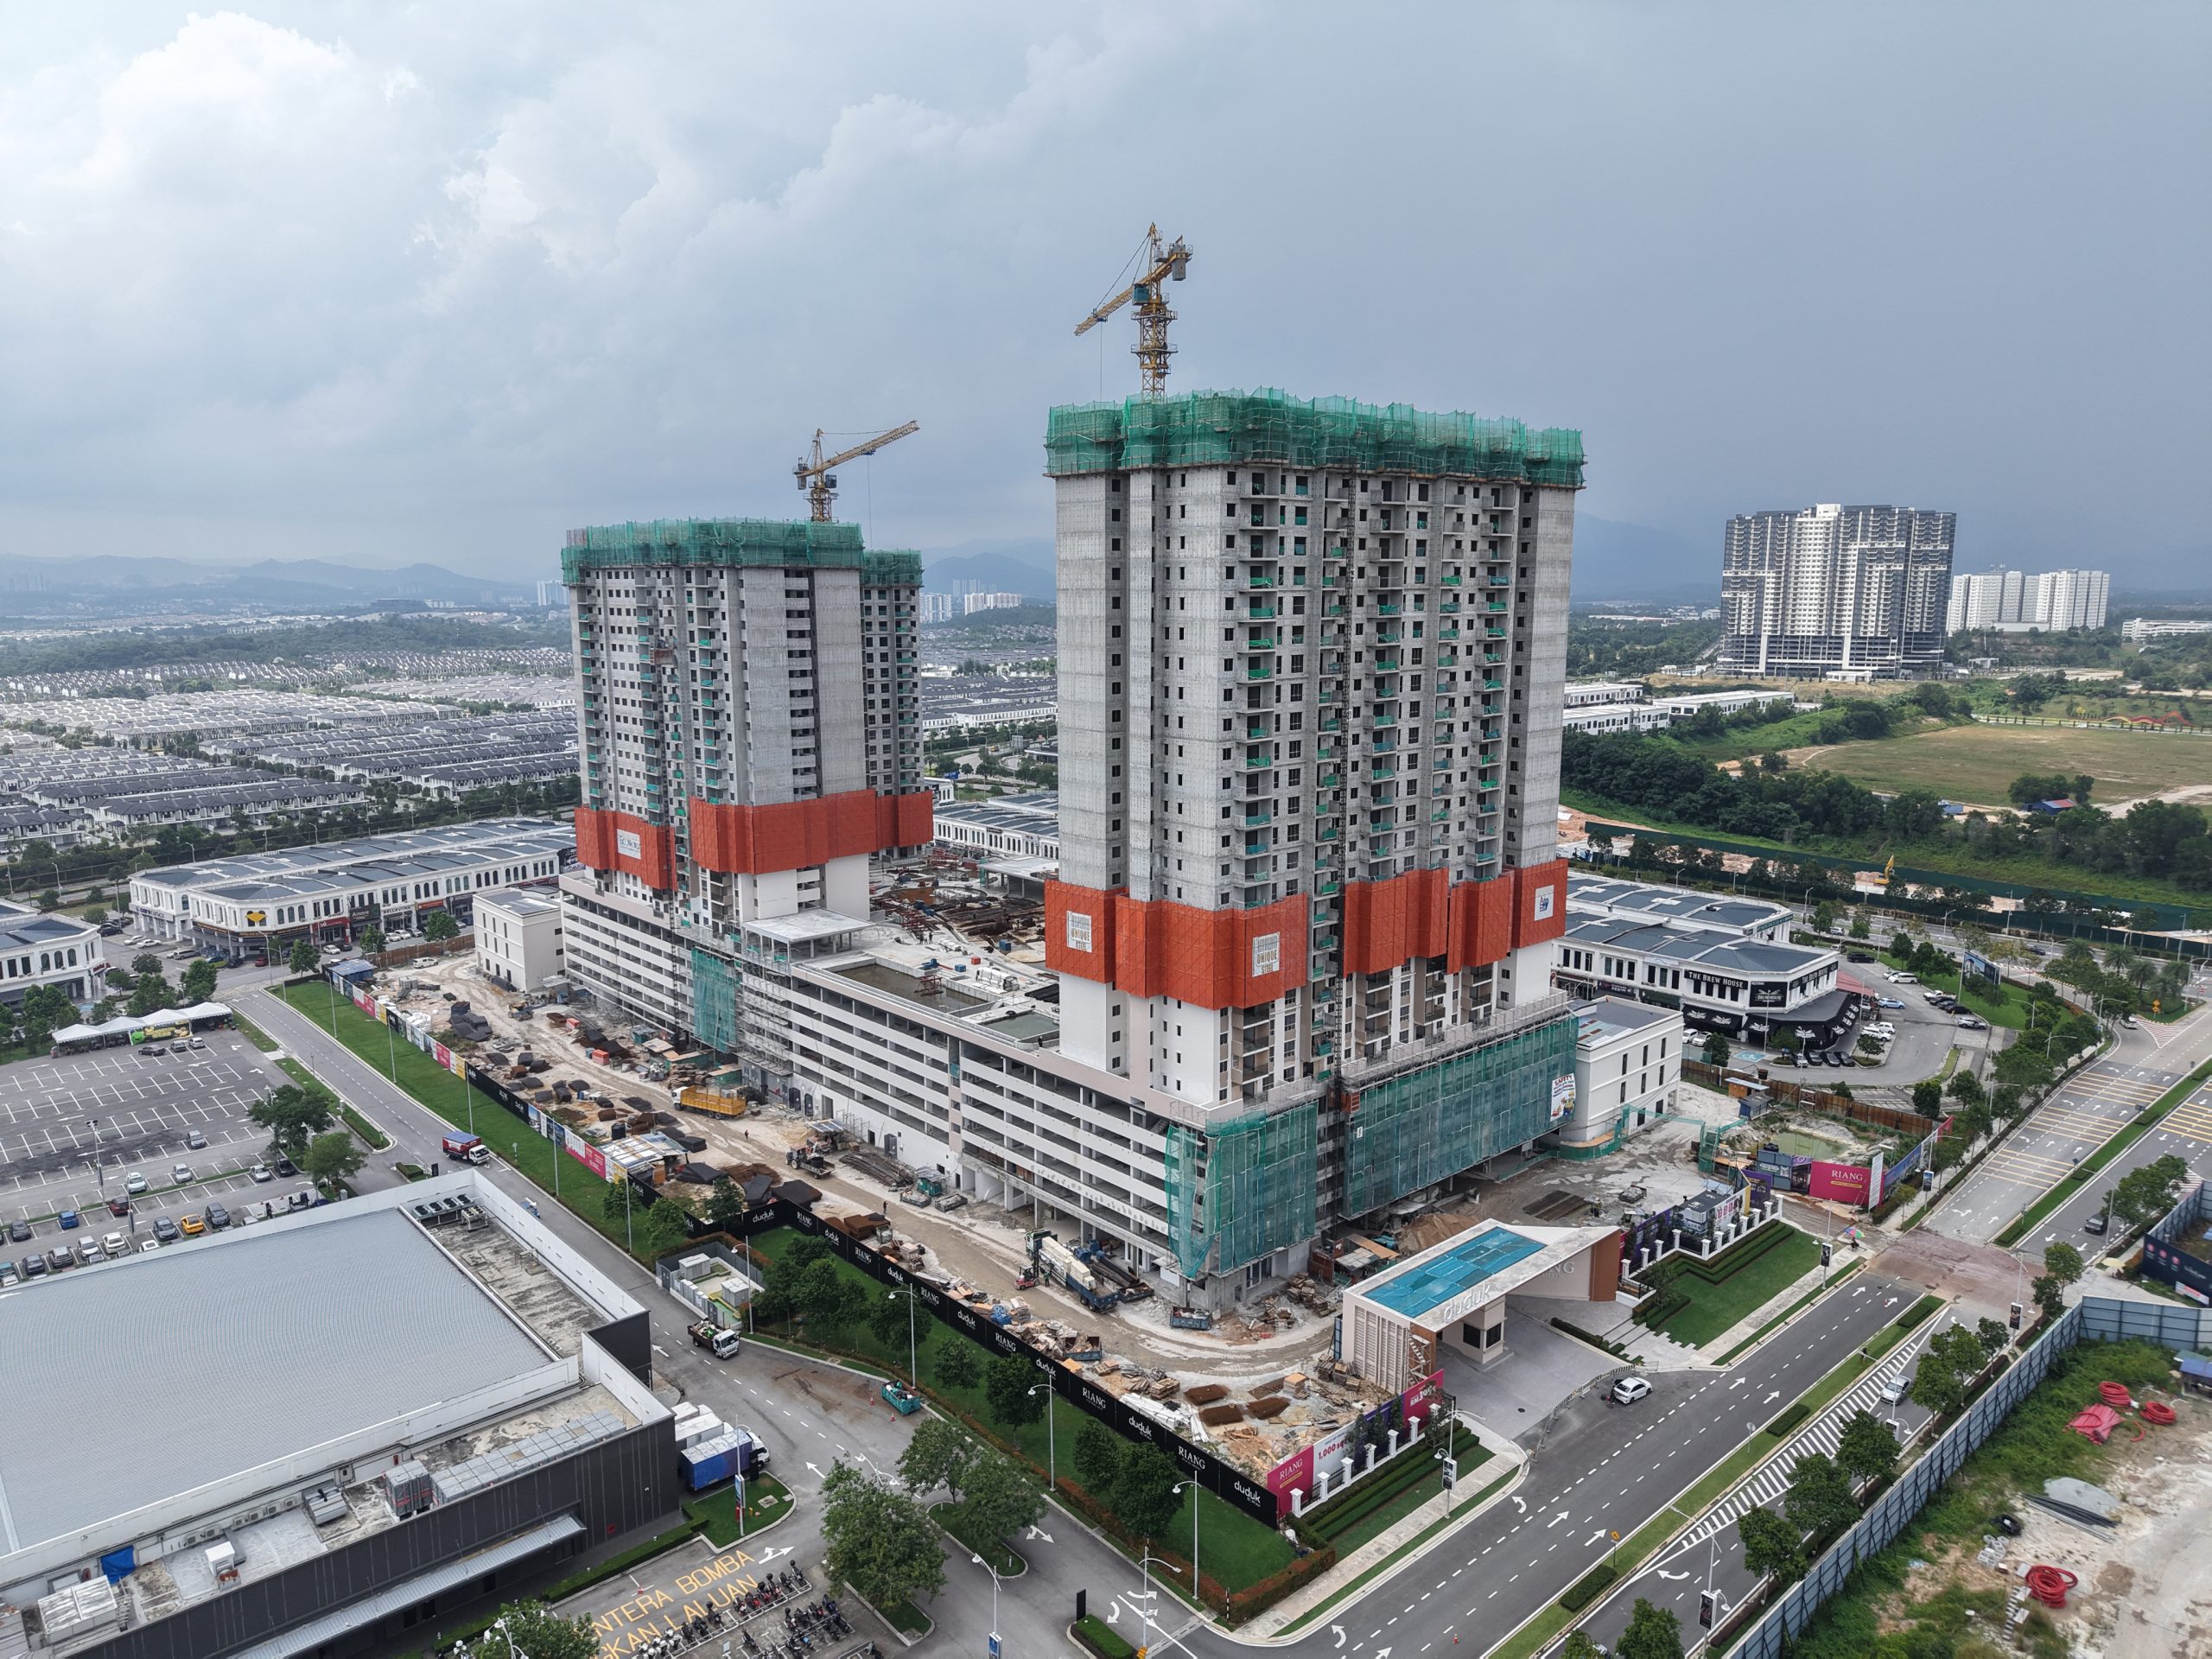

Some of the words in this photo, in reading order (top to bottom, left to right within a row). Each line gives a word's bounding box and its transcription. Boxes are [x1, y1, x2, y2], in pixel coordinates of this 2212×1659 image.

[1257, 950, 1277, 964] UNIQUE
[1688, 971, 1701, 980] THE
[1702, 974, 1721, 984] BREW
[1723, 977, 1744, 988] HOUSE
[1831, 1170, 1863, 1180] RIANG
[752, 1210, 775, 1223] duduk
[797, 1211, 812, 1225] RIANG
[824, 1229, 840, 1243] duduk
[855, 1246, 872, 1263] RIANG
[887, 1268, 904, 1282] duduk
[920, 1287, 939, 1305] RIANG
[1444, 1282, 1491, 1323] duduk
[957, 1310, 976, 1327] duduk
[995, 1332, 1016, 1351] RIANG
[1036, 1358, 1056, 1376] duduk
[1083, 1387, 1106, 1408] RIANG
[1128, 1416, 1152, 1436] duduk
[1179, 1446, 1205, 1469] RIANG
[1280, 1459, 1303, 1480] RIANG
[1234, 1480, 1261, 1503] duduk
[591, 1589, 674, 1637] NTERA
[675, 1549, 755, 1595] BOMBA
